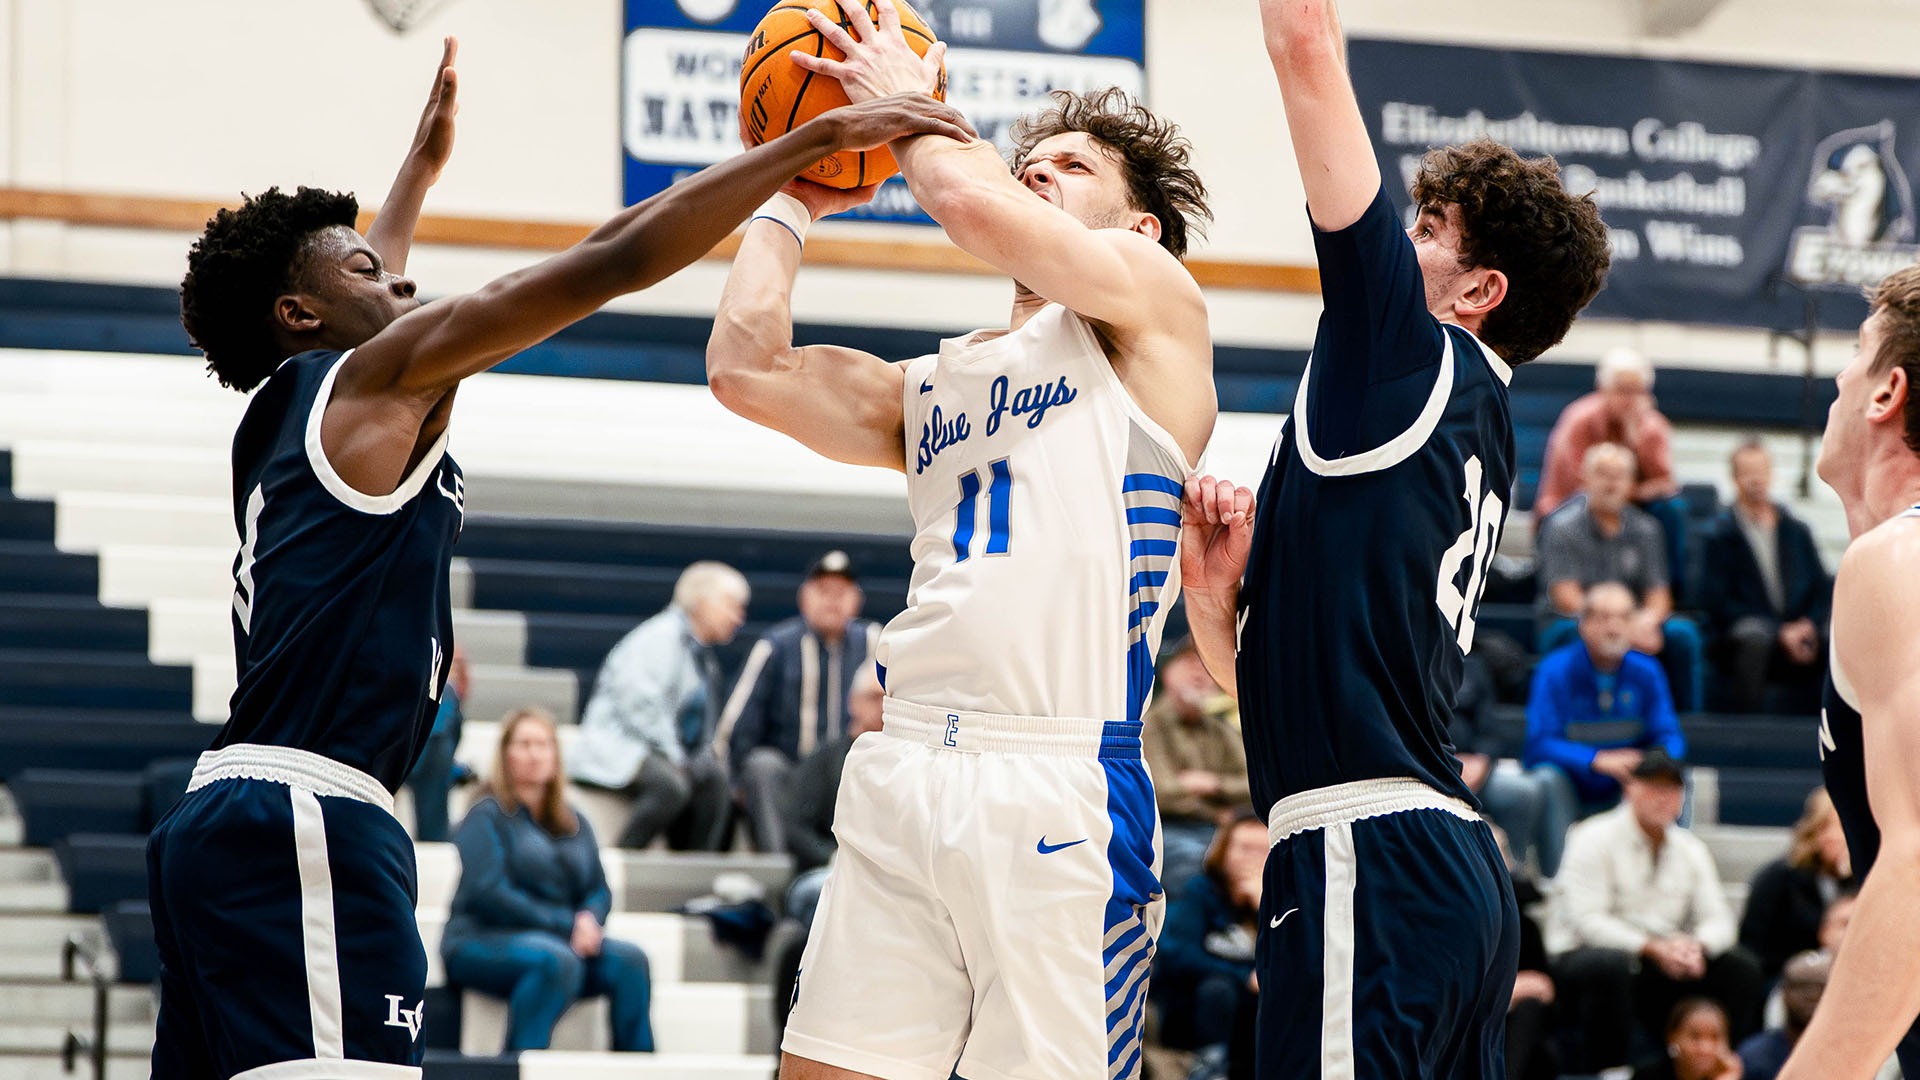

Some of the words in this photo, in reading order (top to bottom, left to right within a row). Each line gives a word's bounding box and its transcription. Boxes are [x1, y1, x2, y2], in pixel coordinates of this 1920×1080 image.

[758, 73, 773, 97] NXT
[1633, 118, 1761, 170] College
[1645, 219, 1745, 268] Wins
[916, 404, 971, 475] Blue
[985, 375, 1078, 438] Jays
[952, 455, 1014, 564] 11
[1435, 454, 1503, 656] 20
[943, 713, 959, 747] E
